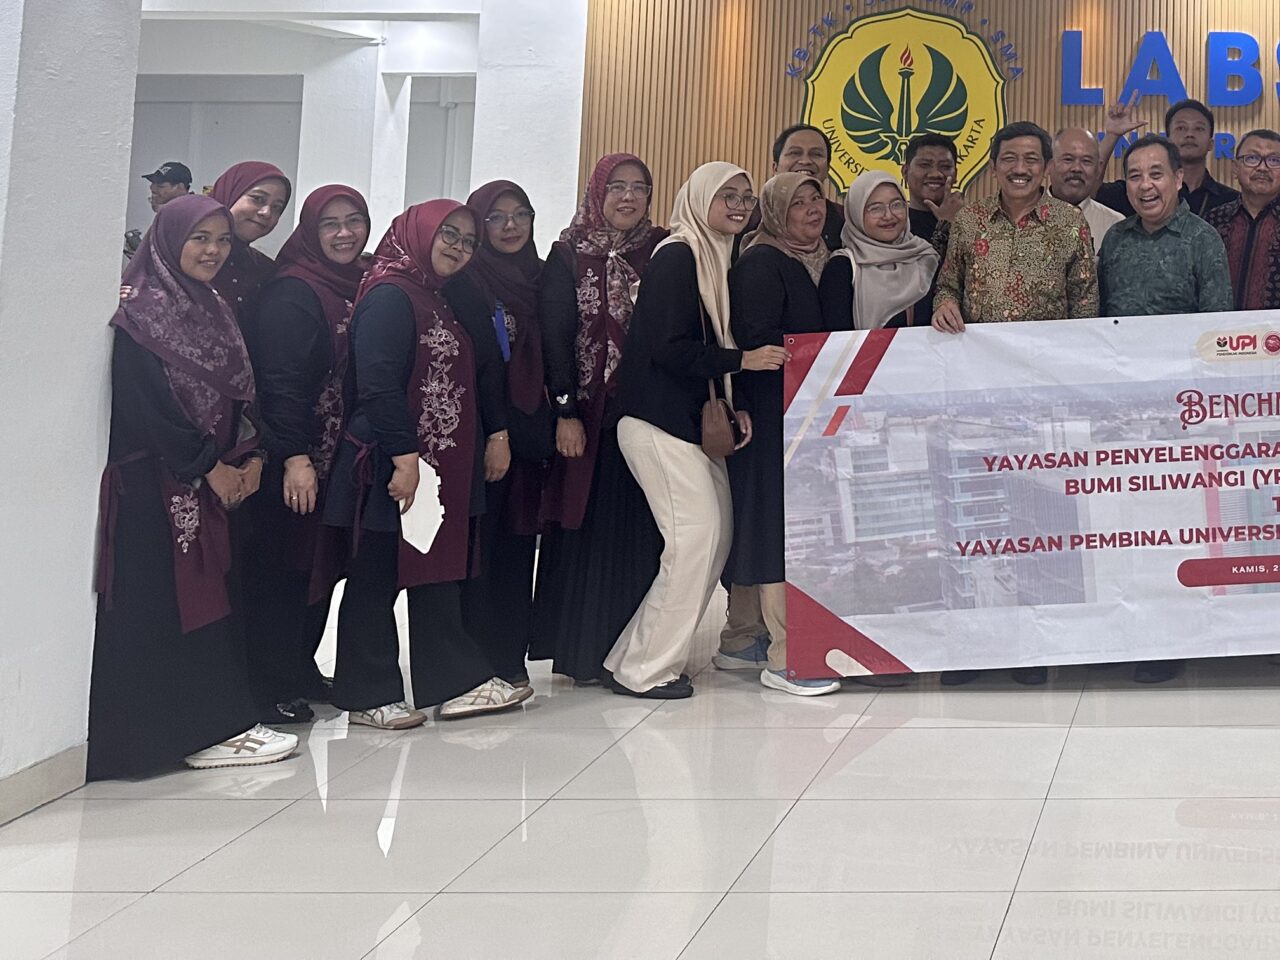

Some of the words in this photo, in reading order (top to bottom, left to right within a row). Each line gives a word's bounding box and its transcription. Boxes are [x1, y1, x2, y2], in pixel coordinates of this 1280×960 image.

[990, 30, 1024, 81] SMA
[822, 118, 870, 177] UNIVERSI
[1228, 334, 1257, 351] UPI
[982, 450, 1089, 472] YAYASAN
[1065, 477, 1122, 495] BUMI
[1128, 470, 1245, 492] SILIWANGI
[956, 534, 1063, 556] YAYASAN
[1069, 529, 1173, 550] PEMBINA
[1232, 565, 1269, 574] KAMIS,
